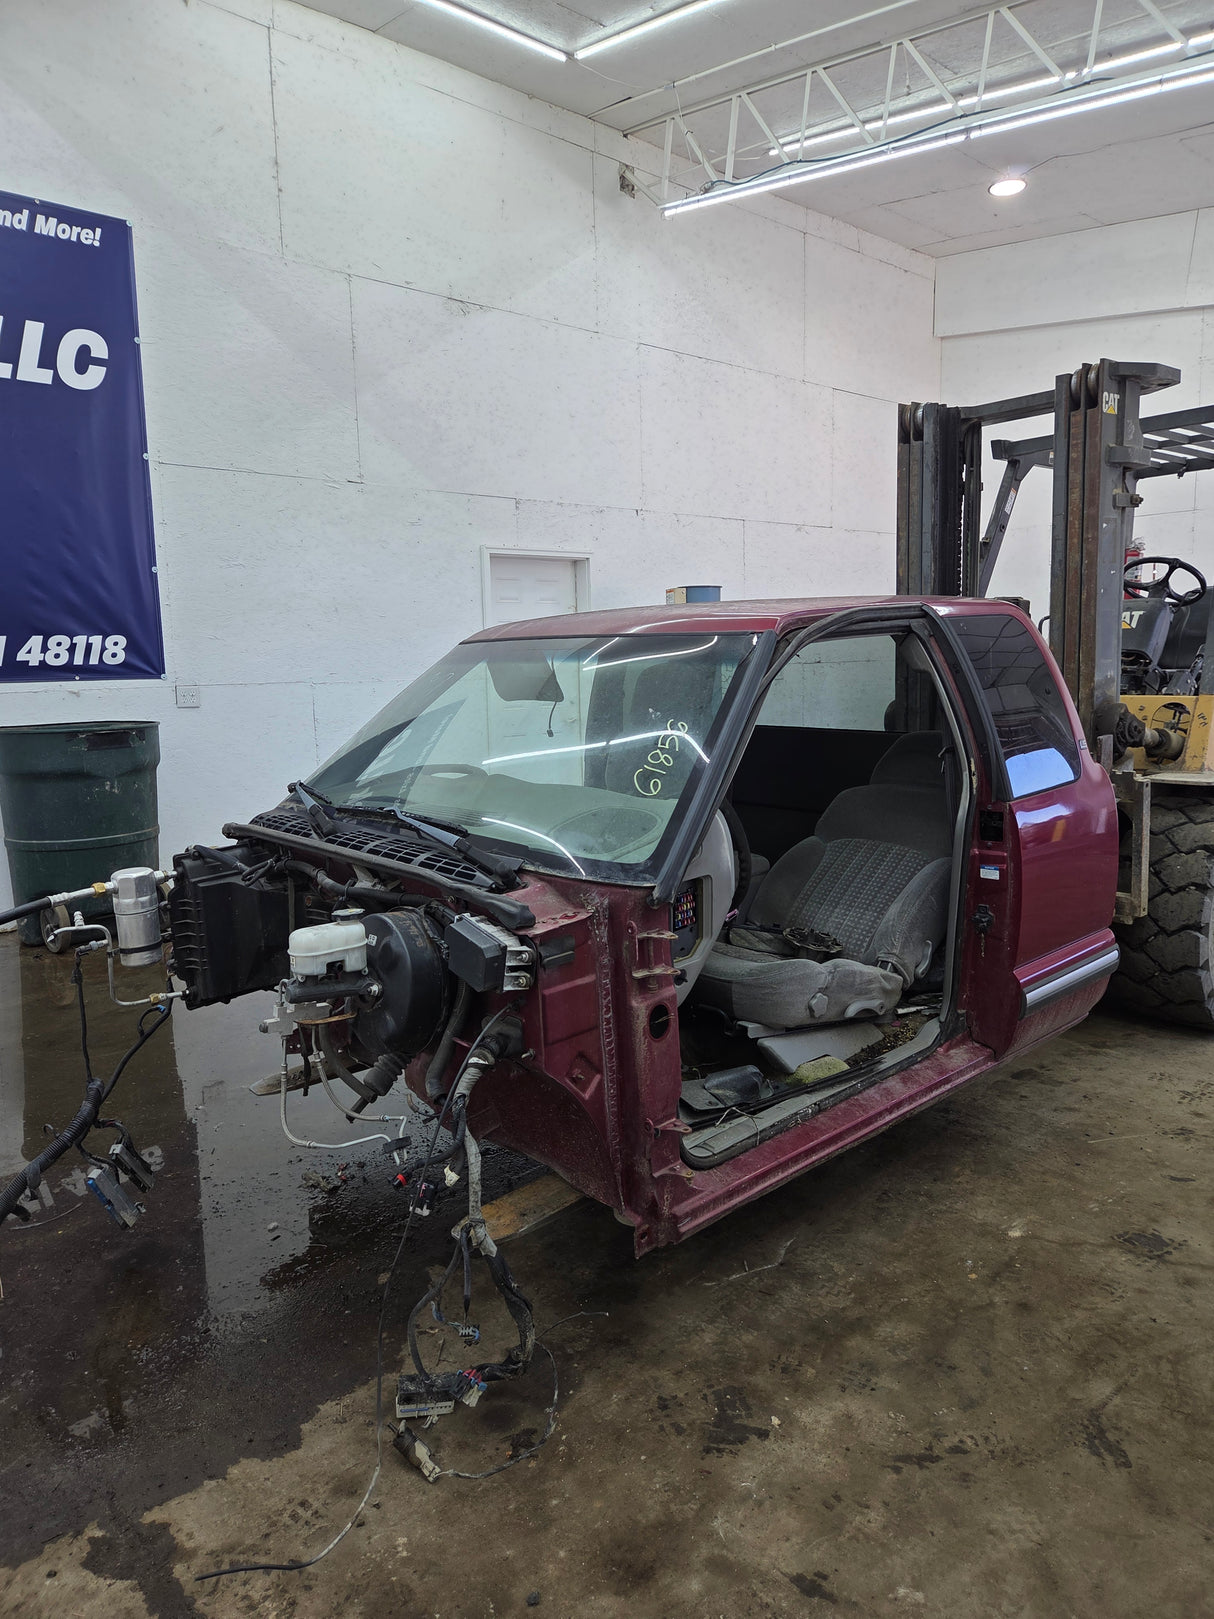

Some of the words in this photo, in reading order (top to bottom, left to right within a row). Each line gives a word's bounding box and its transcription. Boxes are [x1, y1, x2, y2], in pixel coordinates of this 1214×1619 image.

[0, 209, 29, 231] nd
[34, 214, 102, 247] More!
[1103, 391, 1120, 415] CAT
[1121, 610, 1145, 629] AT
[16, 634, 127, 667] 48118
